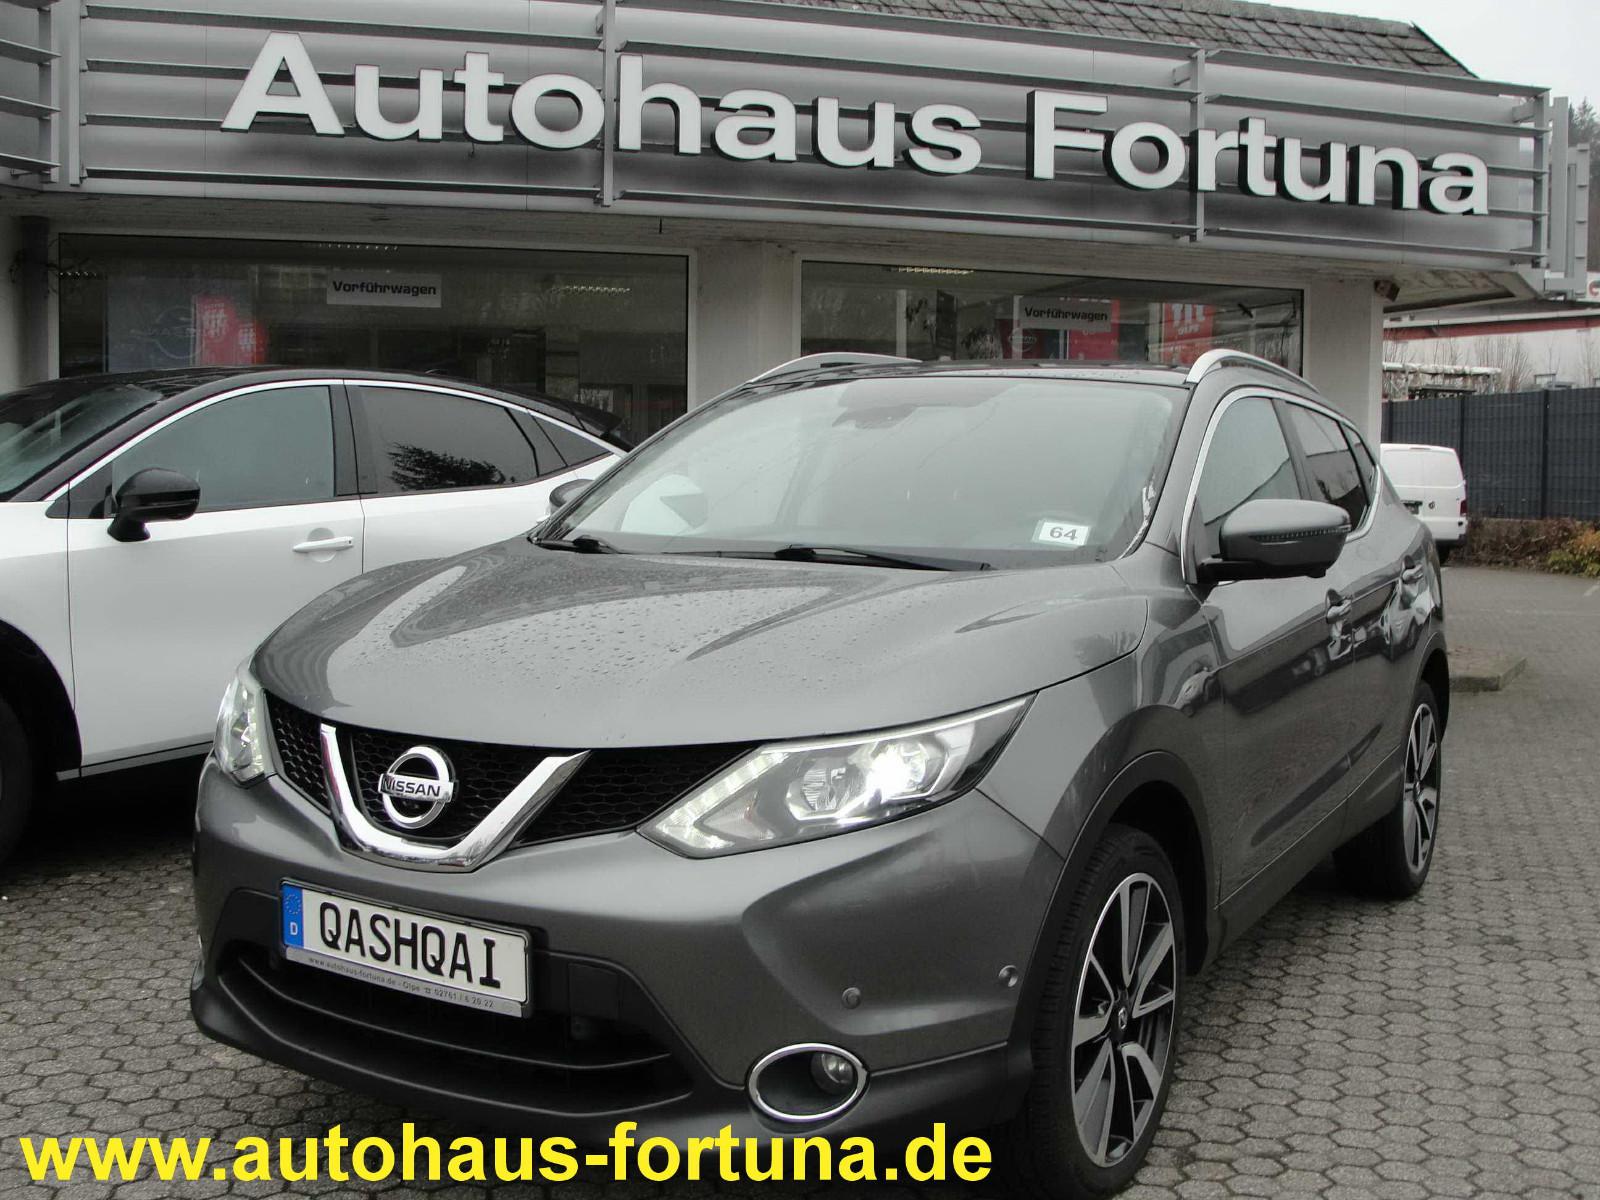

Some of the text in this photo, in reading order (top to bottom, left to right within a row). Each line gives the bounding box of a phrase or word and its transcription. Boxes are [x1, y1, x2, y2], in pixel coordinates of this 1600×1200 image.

[220, 31, 1489, 216] Autohaus Fortuna
[332, 279, 438, 298] Vorführwagen
[1024, 305, 1109, 323] Vorführwagen
[1049, 526, 1079, 542] 64
[381, 776, 441, 797] NISSAN
[290, 921, 298, 935] D
[319, 901, 501, 989] QASHQAI
